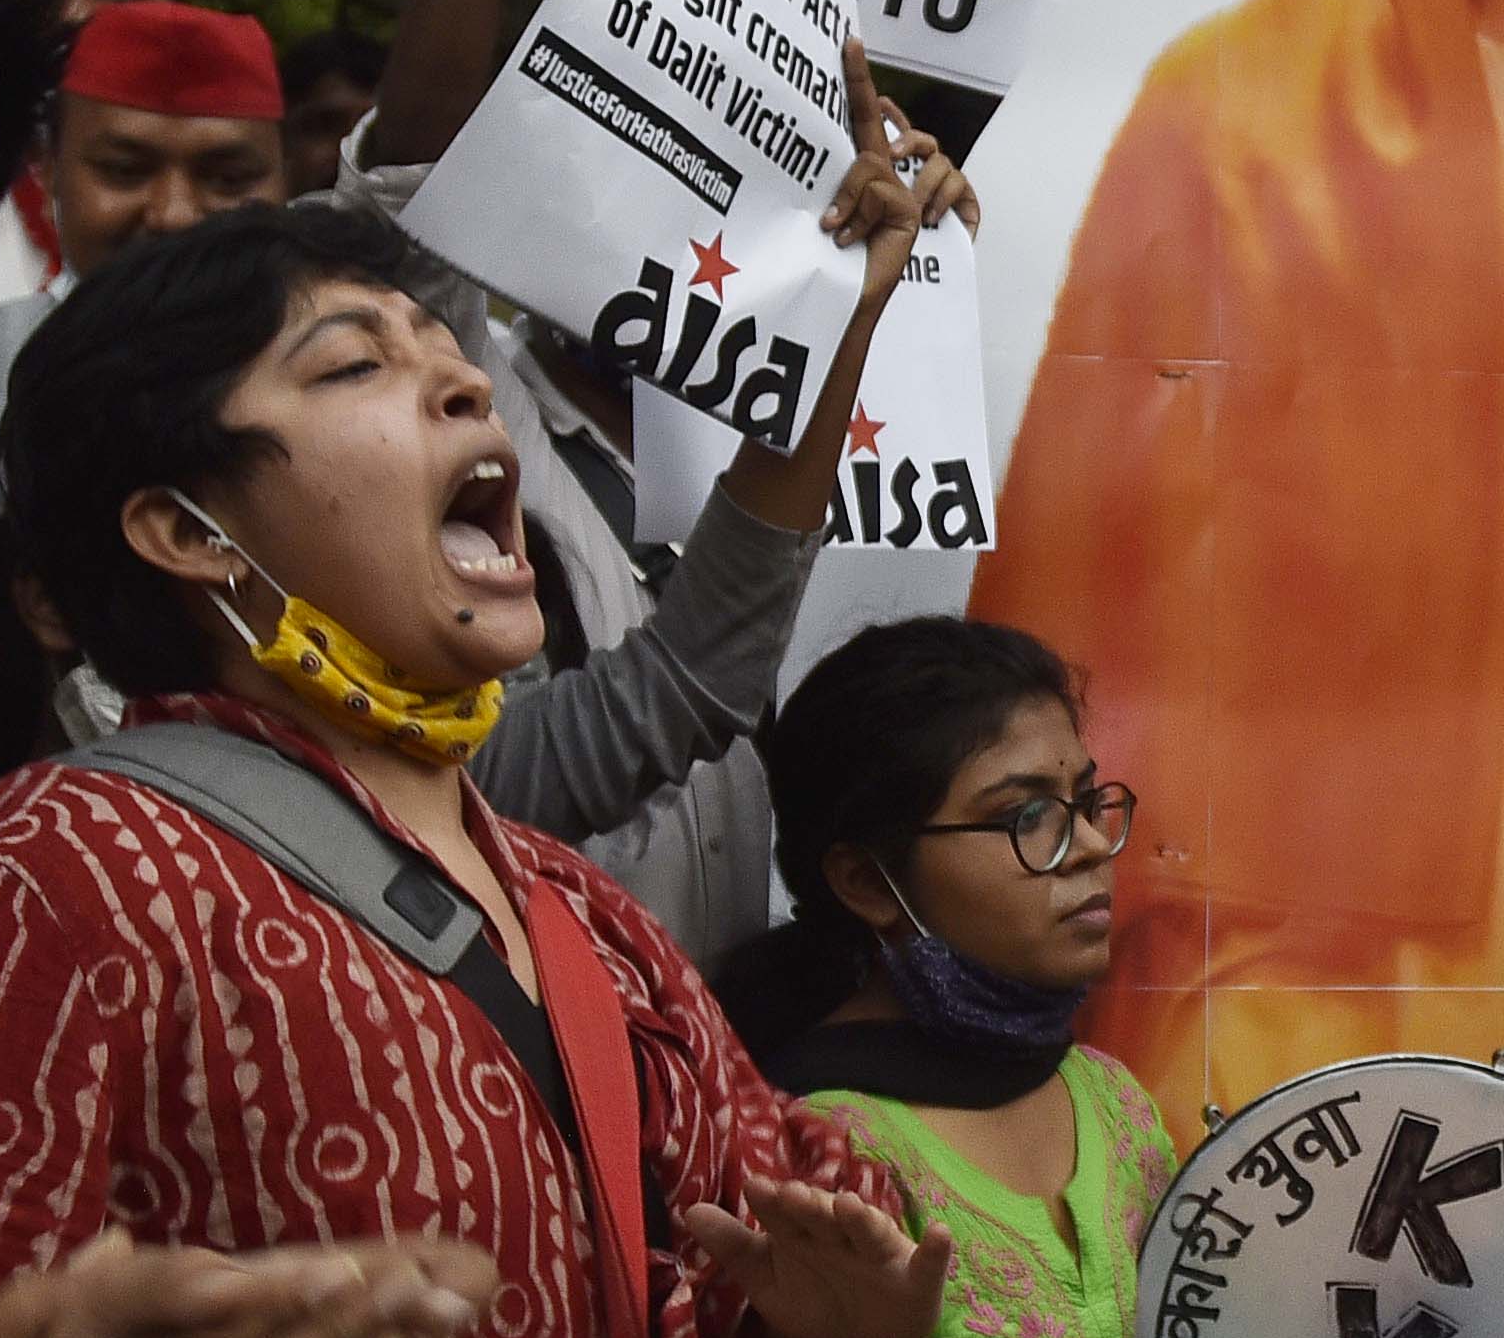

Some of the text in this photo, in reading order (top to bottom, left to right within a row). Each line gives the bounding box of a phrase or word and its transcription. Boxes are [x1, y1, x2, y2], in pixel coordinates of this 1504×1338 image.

[528, 42, 734, 208] #JusticeForHathrasVictim
[646, 16, 727, 112] Dalit
[722, 75, 831, 192] Victim!
[590, 254, 810, 448] aisa
[1225, 1091, 1362, 1228] युवा
